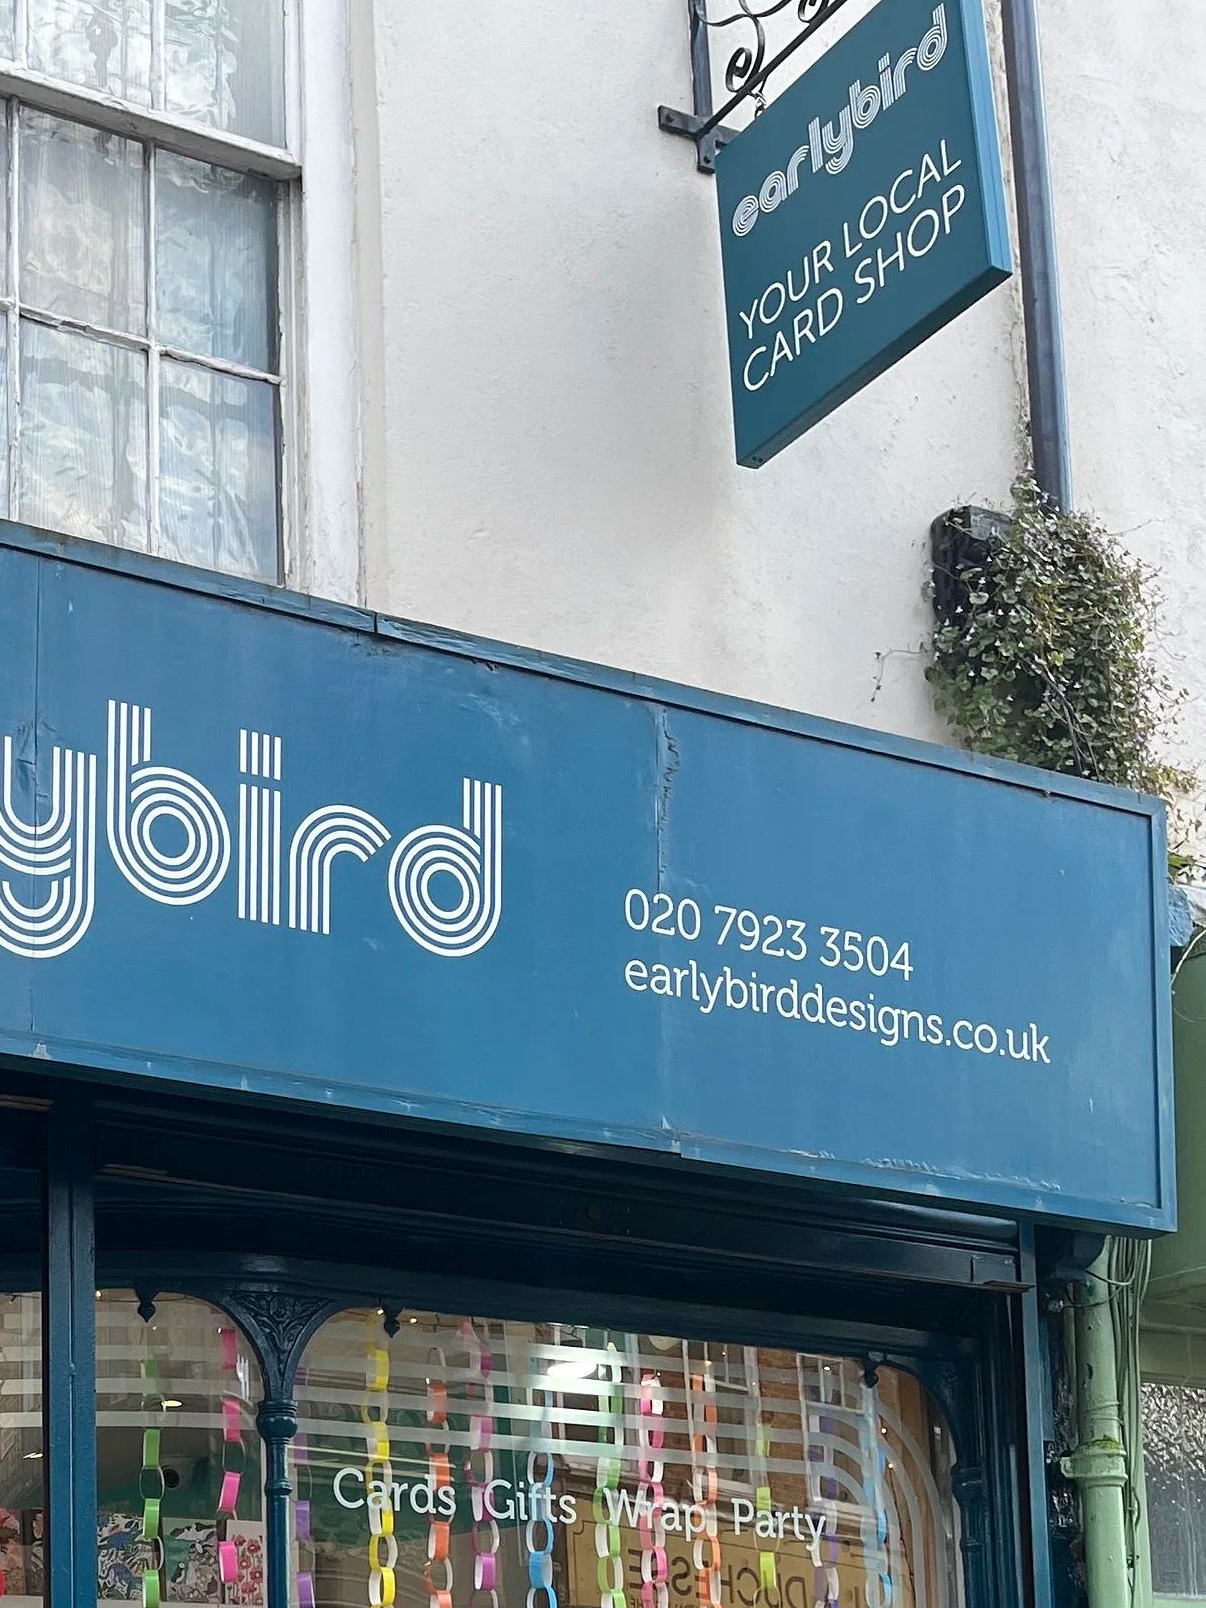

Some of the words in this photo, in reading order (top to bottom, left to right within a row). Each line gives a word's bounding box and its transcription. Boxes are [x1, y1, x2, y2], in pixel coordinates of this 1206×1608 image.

[732, 3, 946, 237] earlybird
[739, 240, 834, 340] YOUR
[843, 139, 962, 259] LOCAL
[742, 288, 843, 391] CARD
[854, 184, 965, 304] SHOP
[624, 888, 701, 941] 020
[713, 905, 808, 961] 7923
[819, 925, 914, 981] 3504
[624, 957, 1051, 1064] earlybirddesigns.co.uk
[332, 1467, 456, 1517] Cards
[483, 1477, 577, 1525] Gifts
[603, 1487, 707, 1542] Wrap
[731, 1498, 826, 1551] Party
